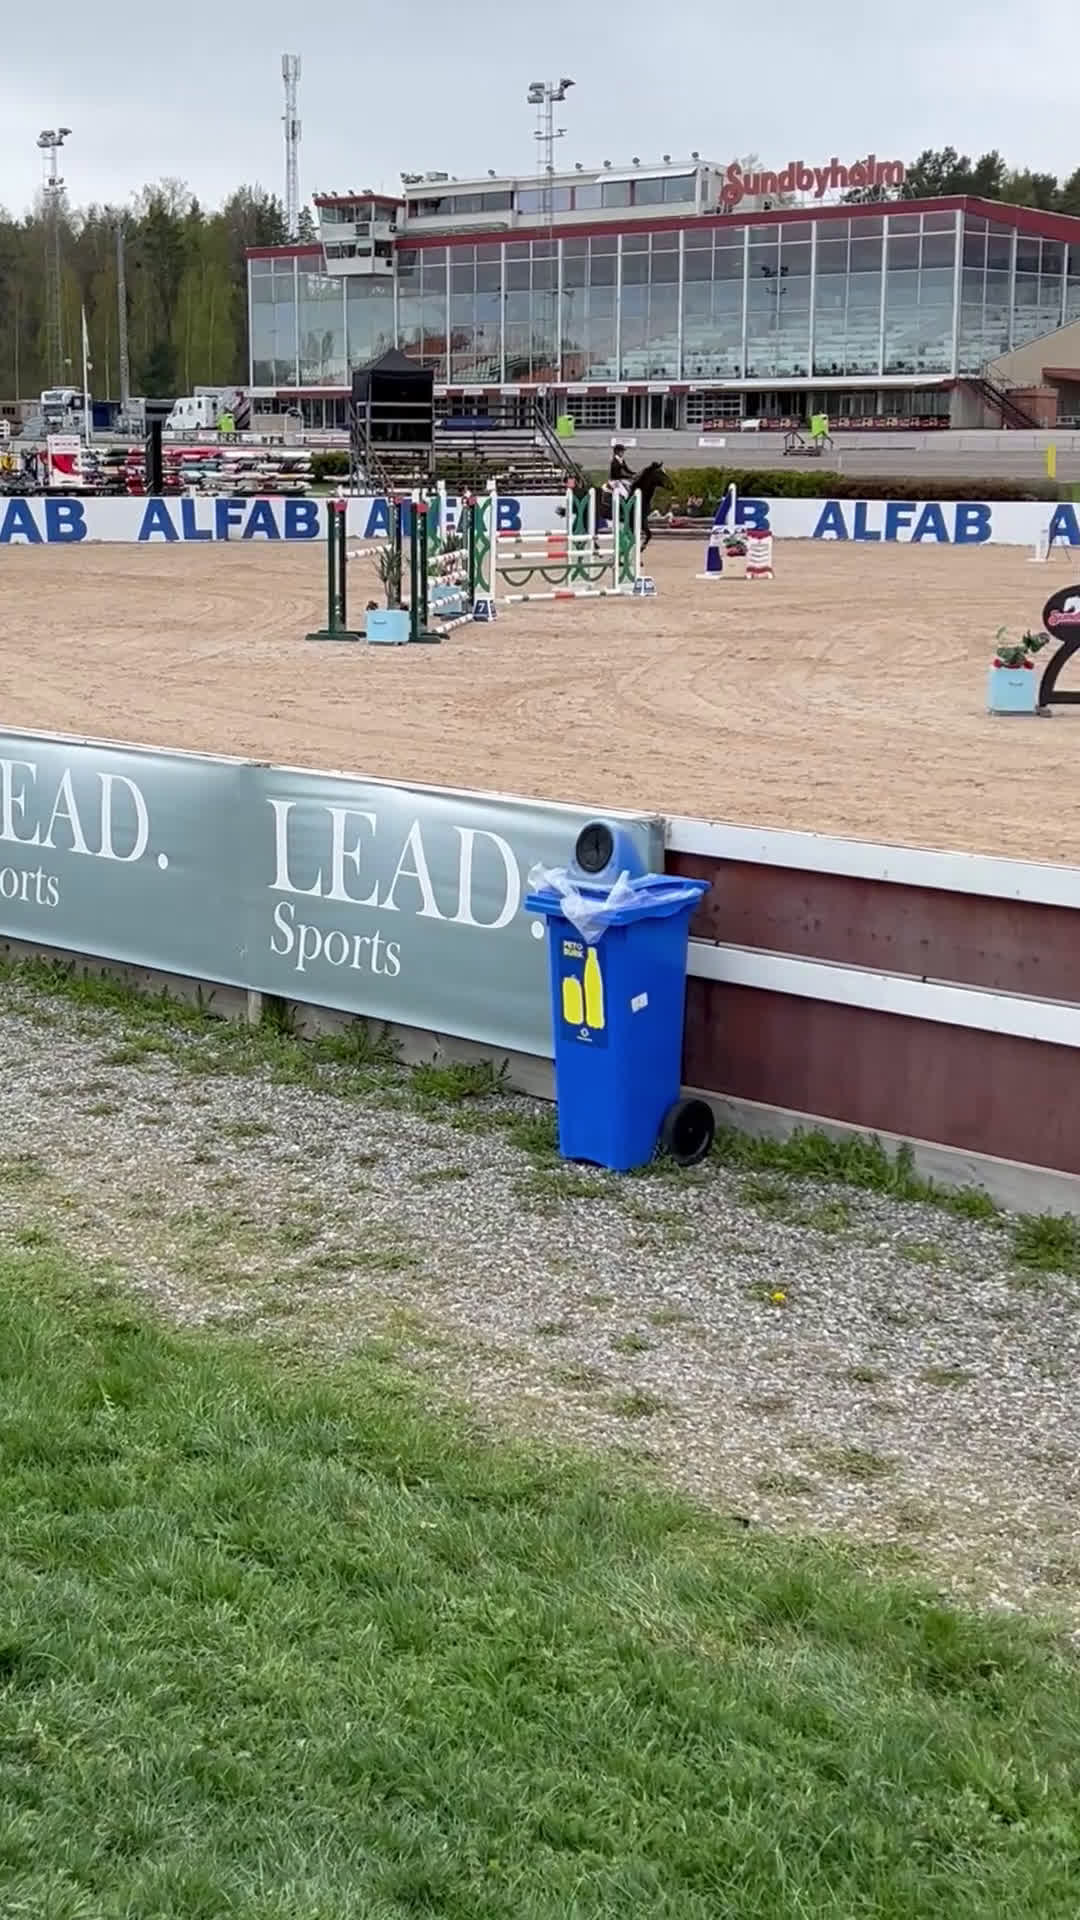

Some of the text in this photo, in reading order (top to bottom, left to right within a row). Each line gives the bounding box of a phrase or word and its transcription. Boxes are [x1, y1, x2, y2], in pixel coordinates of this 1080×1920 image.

[720, 154, 905, 206] Sundbyholm
[138, 499, 320, 541] ALFAB
[813, 501, 992, 544] ALFAB
[266, 799, 545, 940] LEAD.
[270, 901, 401, 977] Sports
